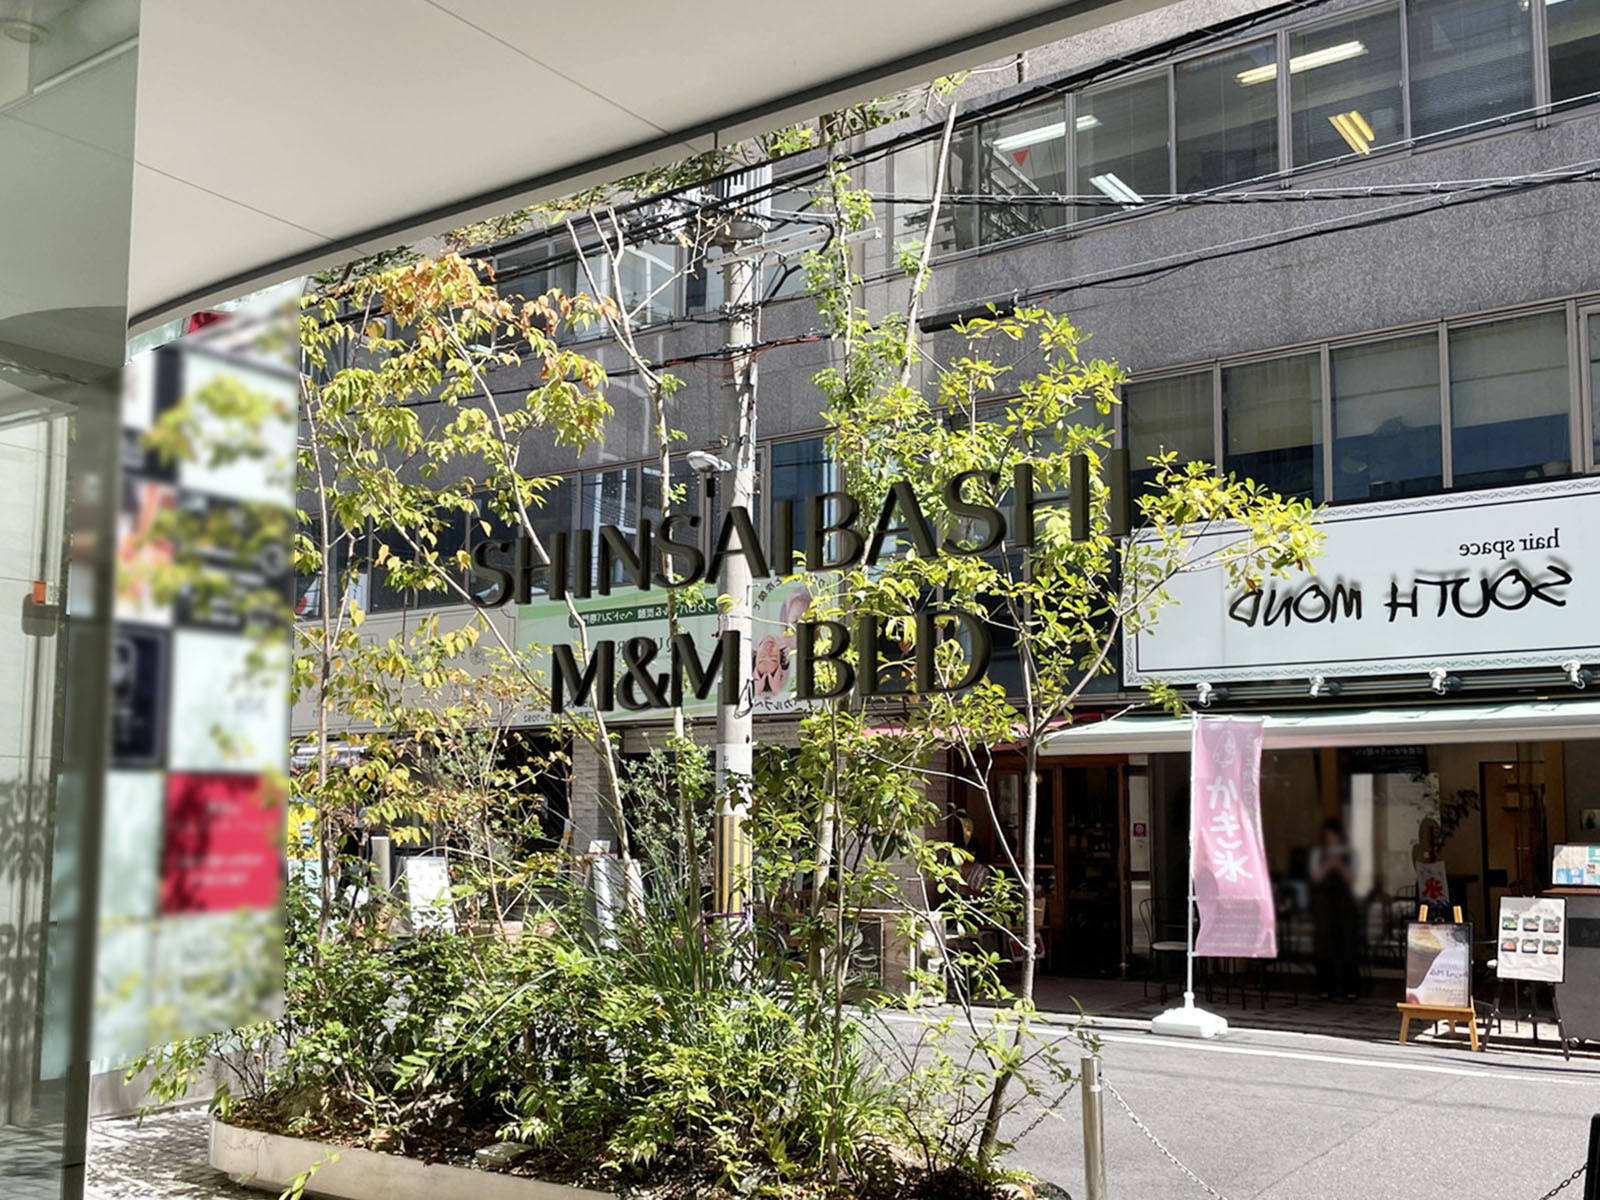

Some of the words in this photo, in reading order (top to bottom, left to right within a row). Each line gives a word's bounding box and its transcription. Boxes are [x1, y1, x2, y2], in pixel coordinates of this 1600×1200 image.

[471, 448, 1131, 609] SHINSAIBASHI
[551, 630, 741, 713] M&M
[796, 611, 992, 700] BLD
[1206, 775, 1253, 883] かき氷
